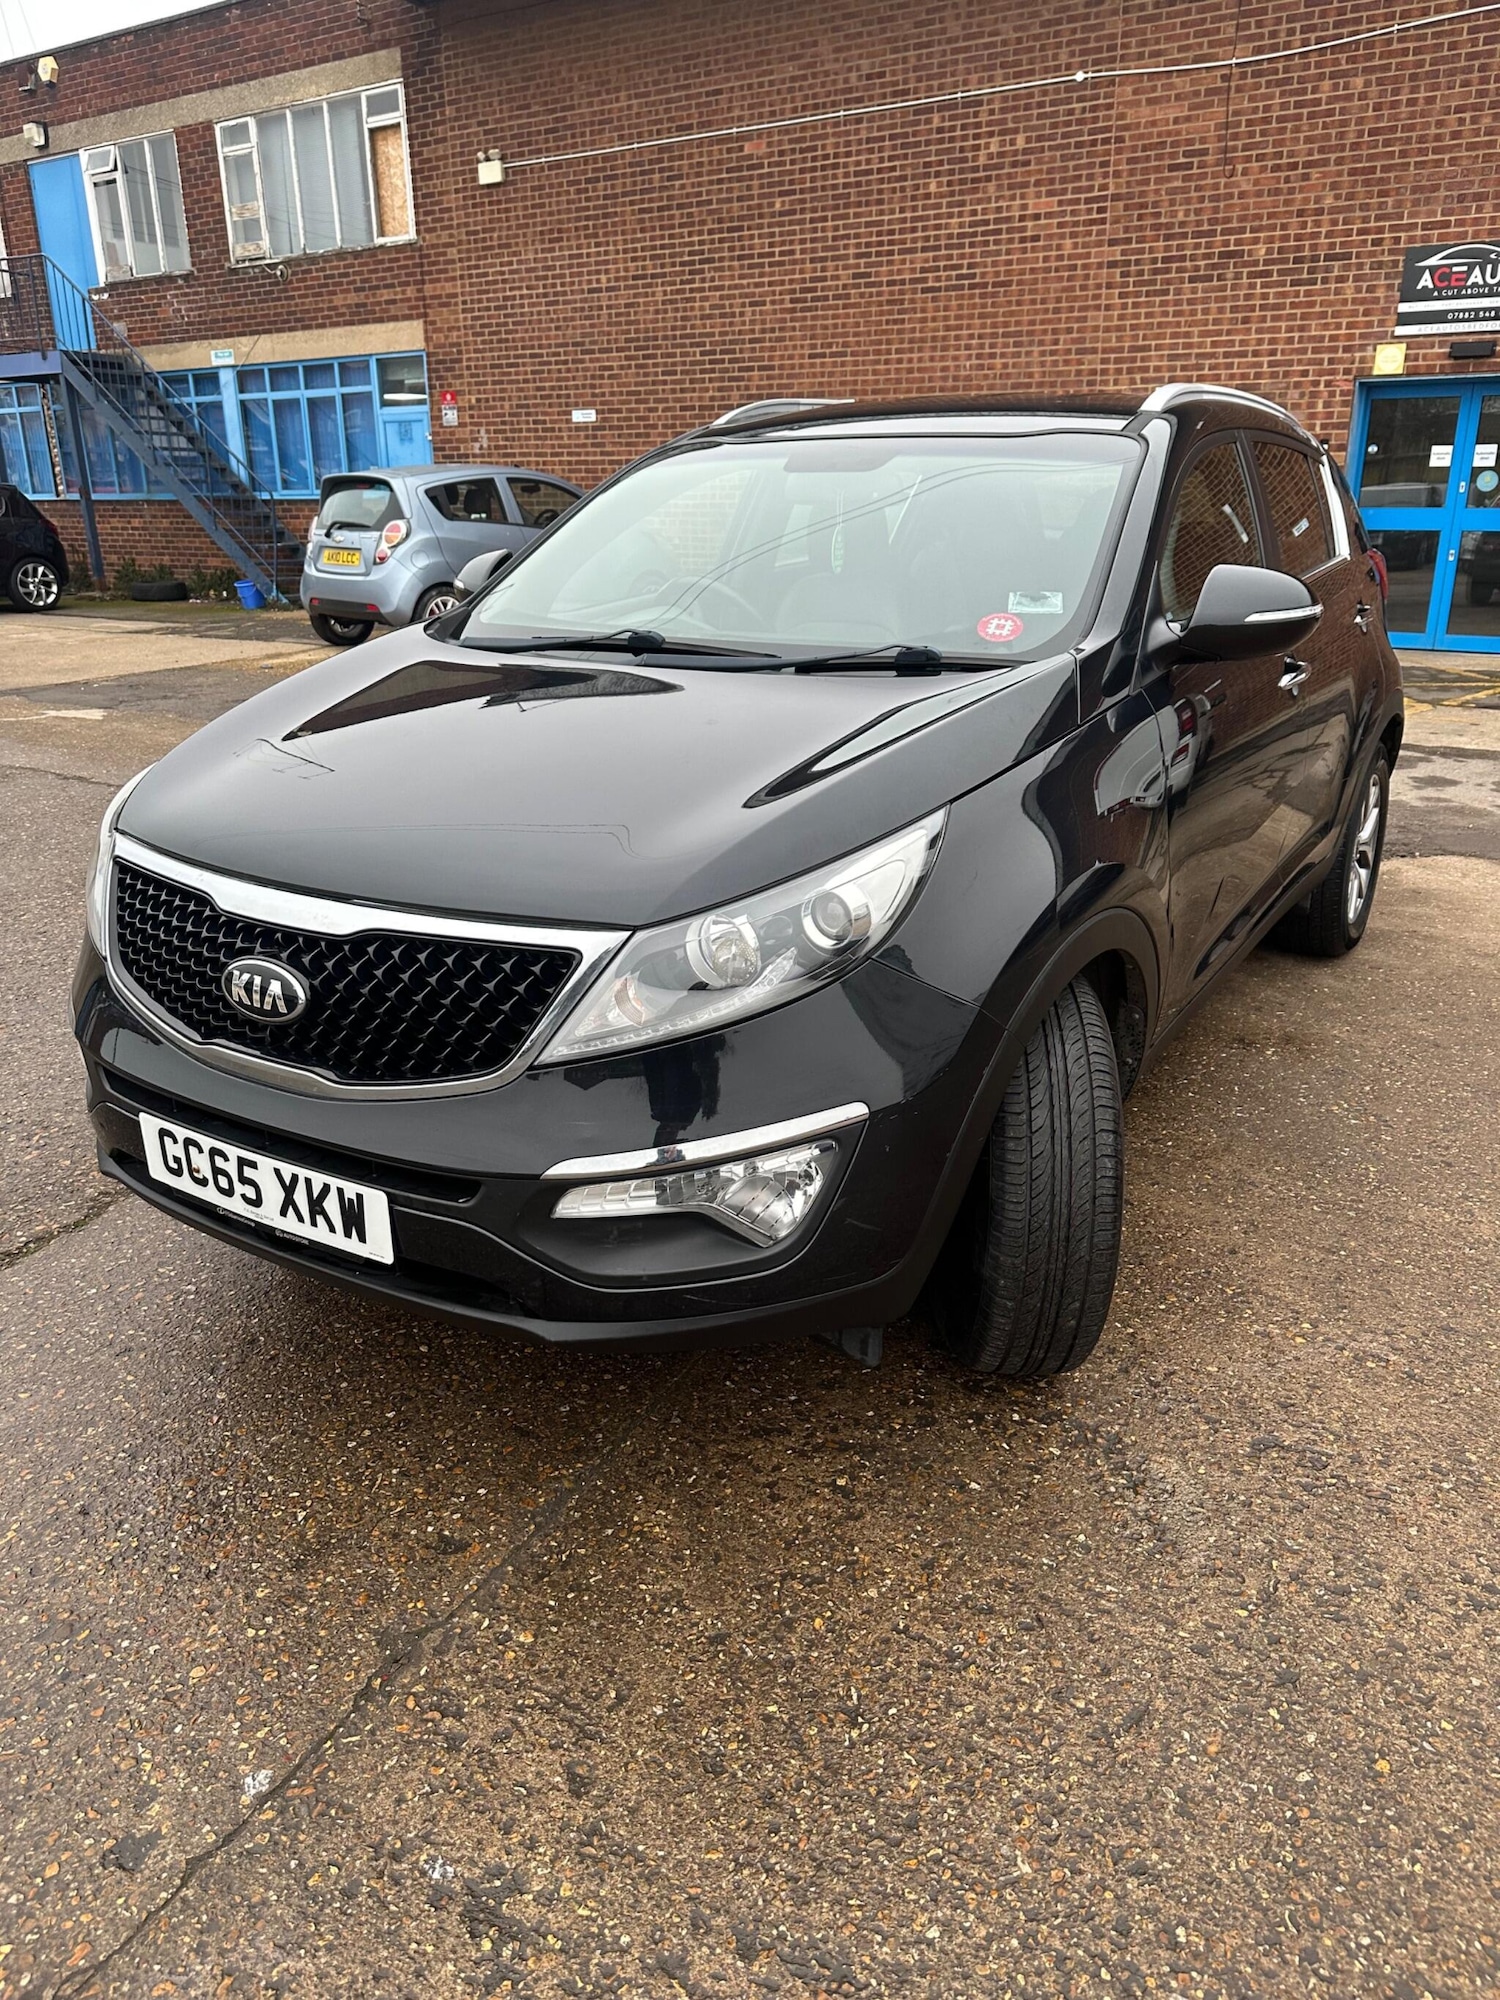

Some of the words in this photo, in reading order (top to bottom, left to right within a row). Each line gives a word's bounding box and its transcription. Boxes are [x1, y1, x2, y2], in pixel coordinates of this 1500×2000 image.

[1461, 287, 1489, 295] ABOVE
[1447, 311, 1475, 319] 07882
[342, 553, 356, 564] LCC
[231, 969, 288, 1014] KIA
[158, 1127, 264, 1209] GC65
[273, 1167, 367, 1245] XKW
